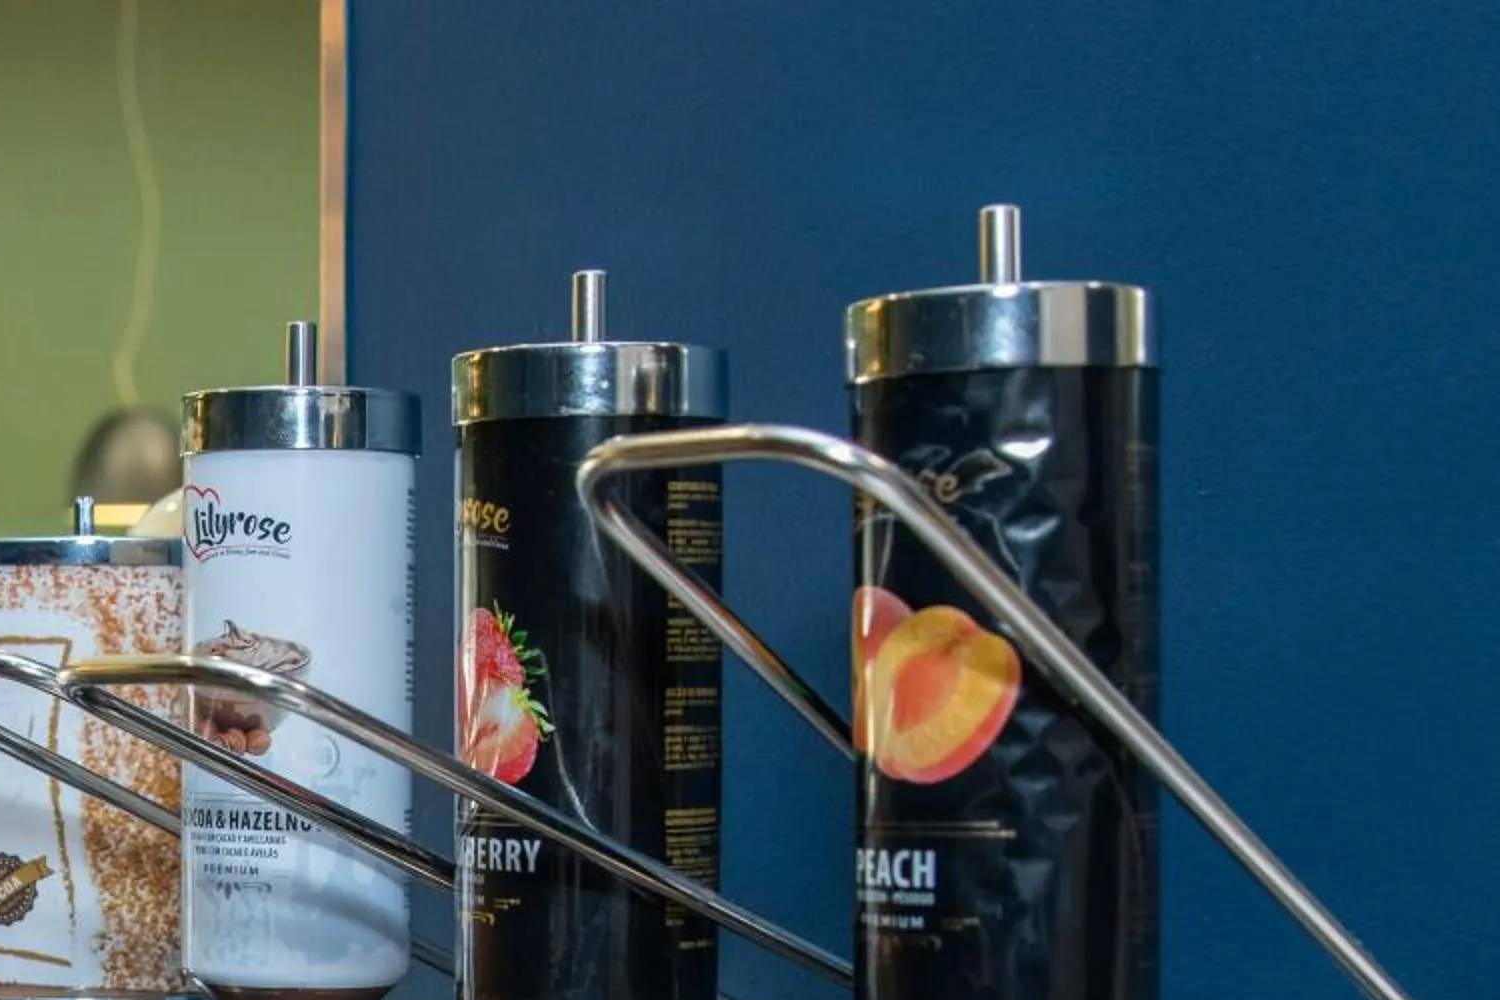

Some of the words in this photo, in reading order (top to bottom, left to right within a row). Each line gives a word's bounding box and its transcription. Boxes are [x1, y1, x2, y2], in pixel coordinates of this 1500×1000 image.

[194, 501, 293, 550] Lilyrose
[461, 497, 512, 533] rose
[215, 809, 227, 829] &
[229, 809, 322, 832] HAZELNU
[203, 862, 260, 876] PREMIUM
[462, 835, 541, 873] BERRY
[856, 847, 936, 889] PEACH
